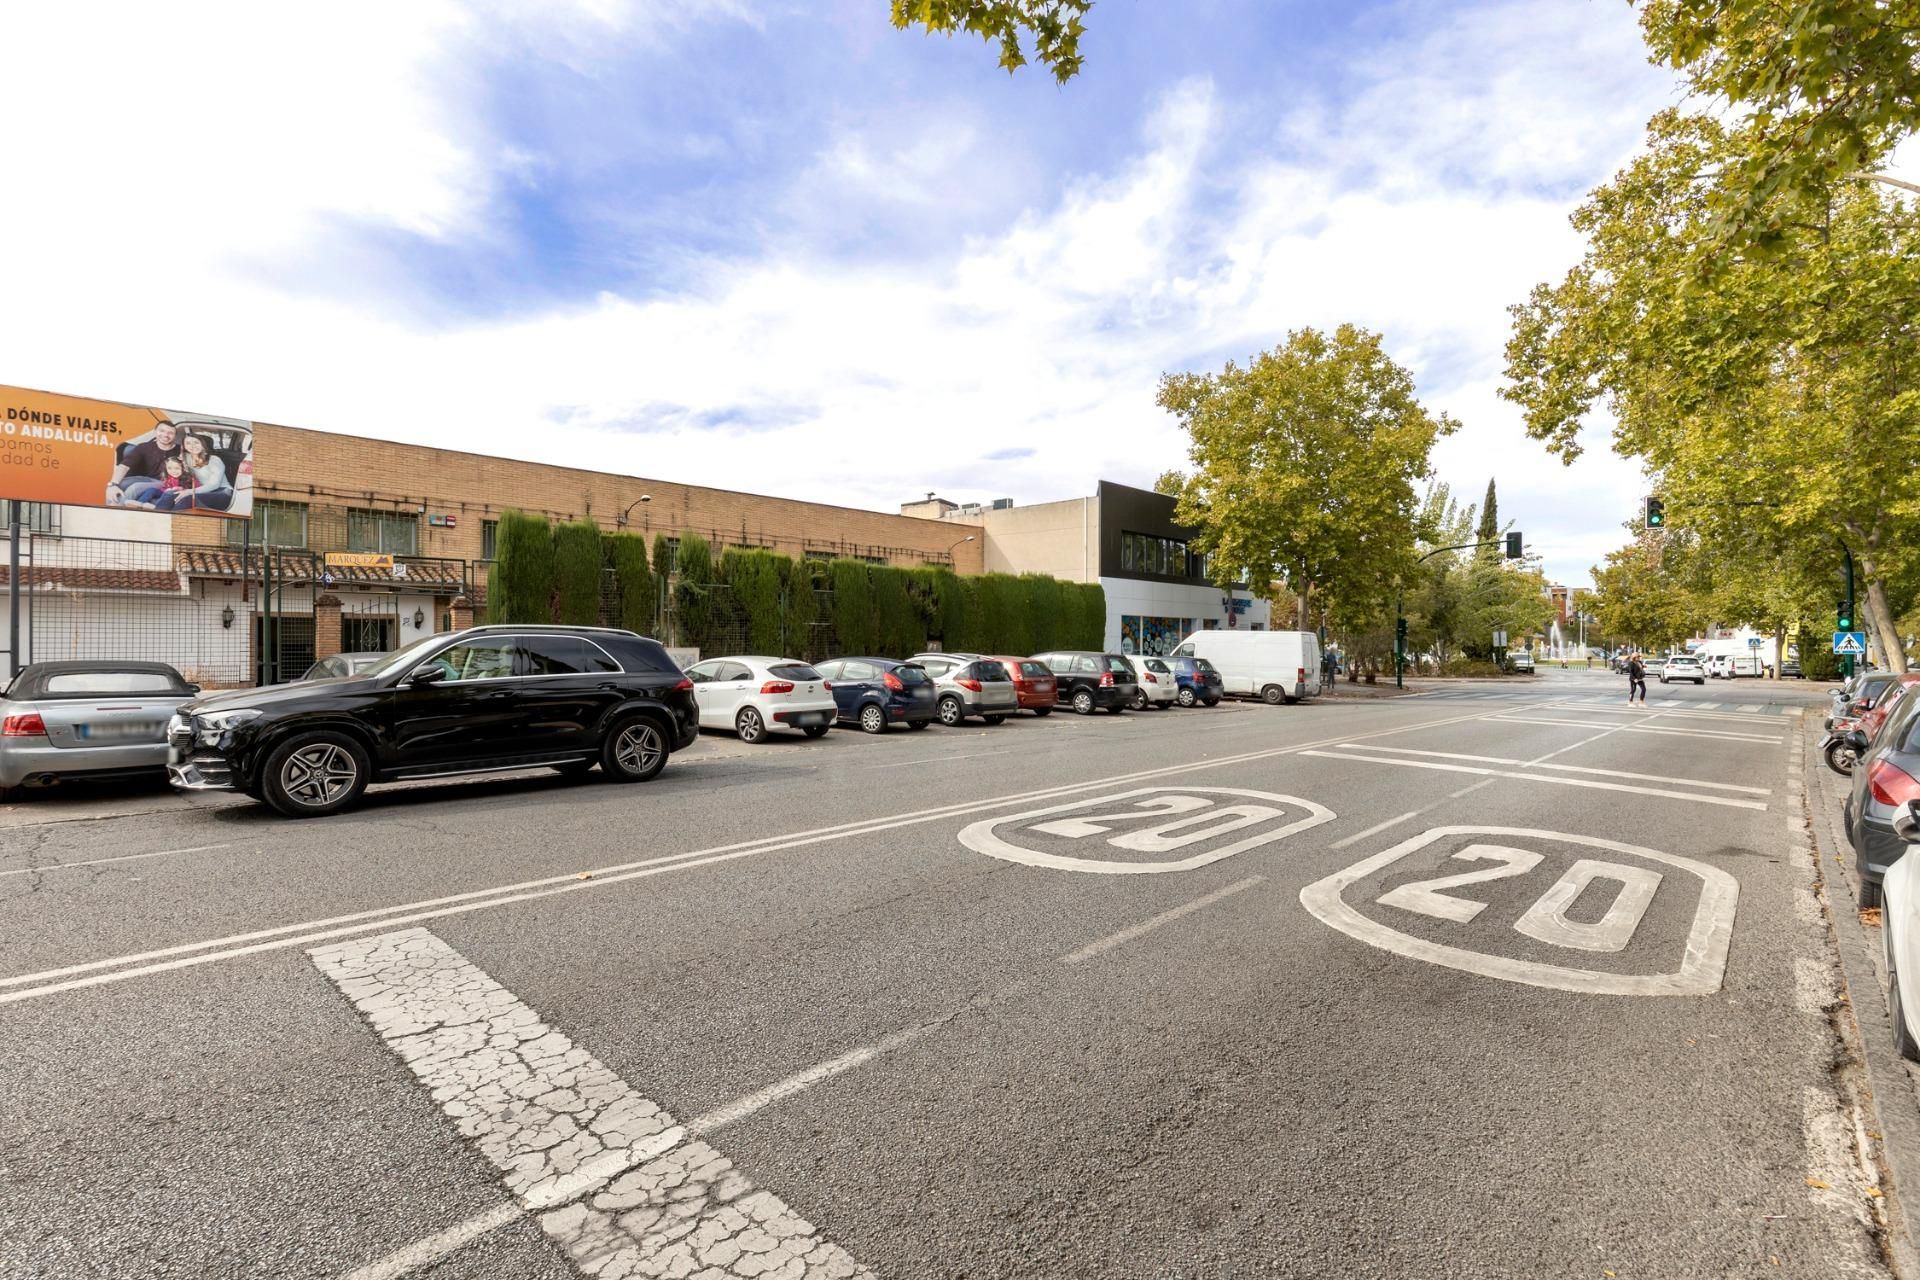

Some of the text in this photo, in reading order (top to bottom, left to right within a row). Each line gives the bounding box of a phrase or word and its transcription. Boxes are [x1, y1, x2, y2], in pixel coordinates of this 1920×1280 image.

[7, 407, 122, 435] DÓNDE VIAJES,
[21, 424, 114, 448] ANDALUCÍA,
[40, 456, 60, 469] de
[1028, 797, 1285, 852] 20
[1376, 845, 1663, 951] 20
